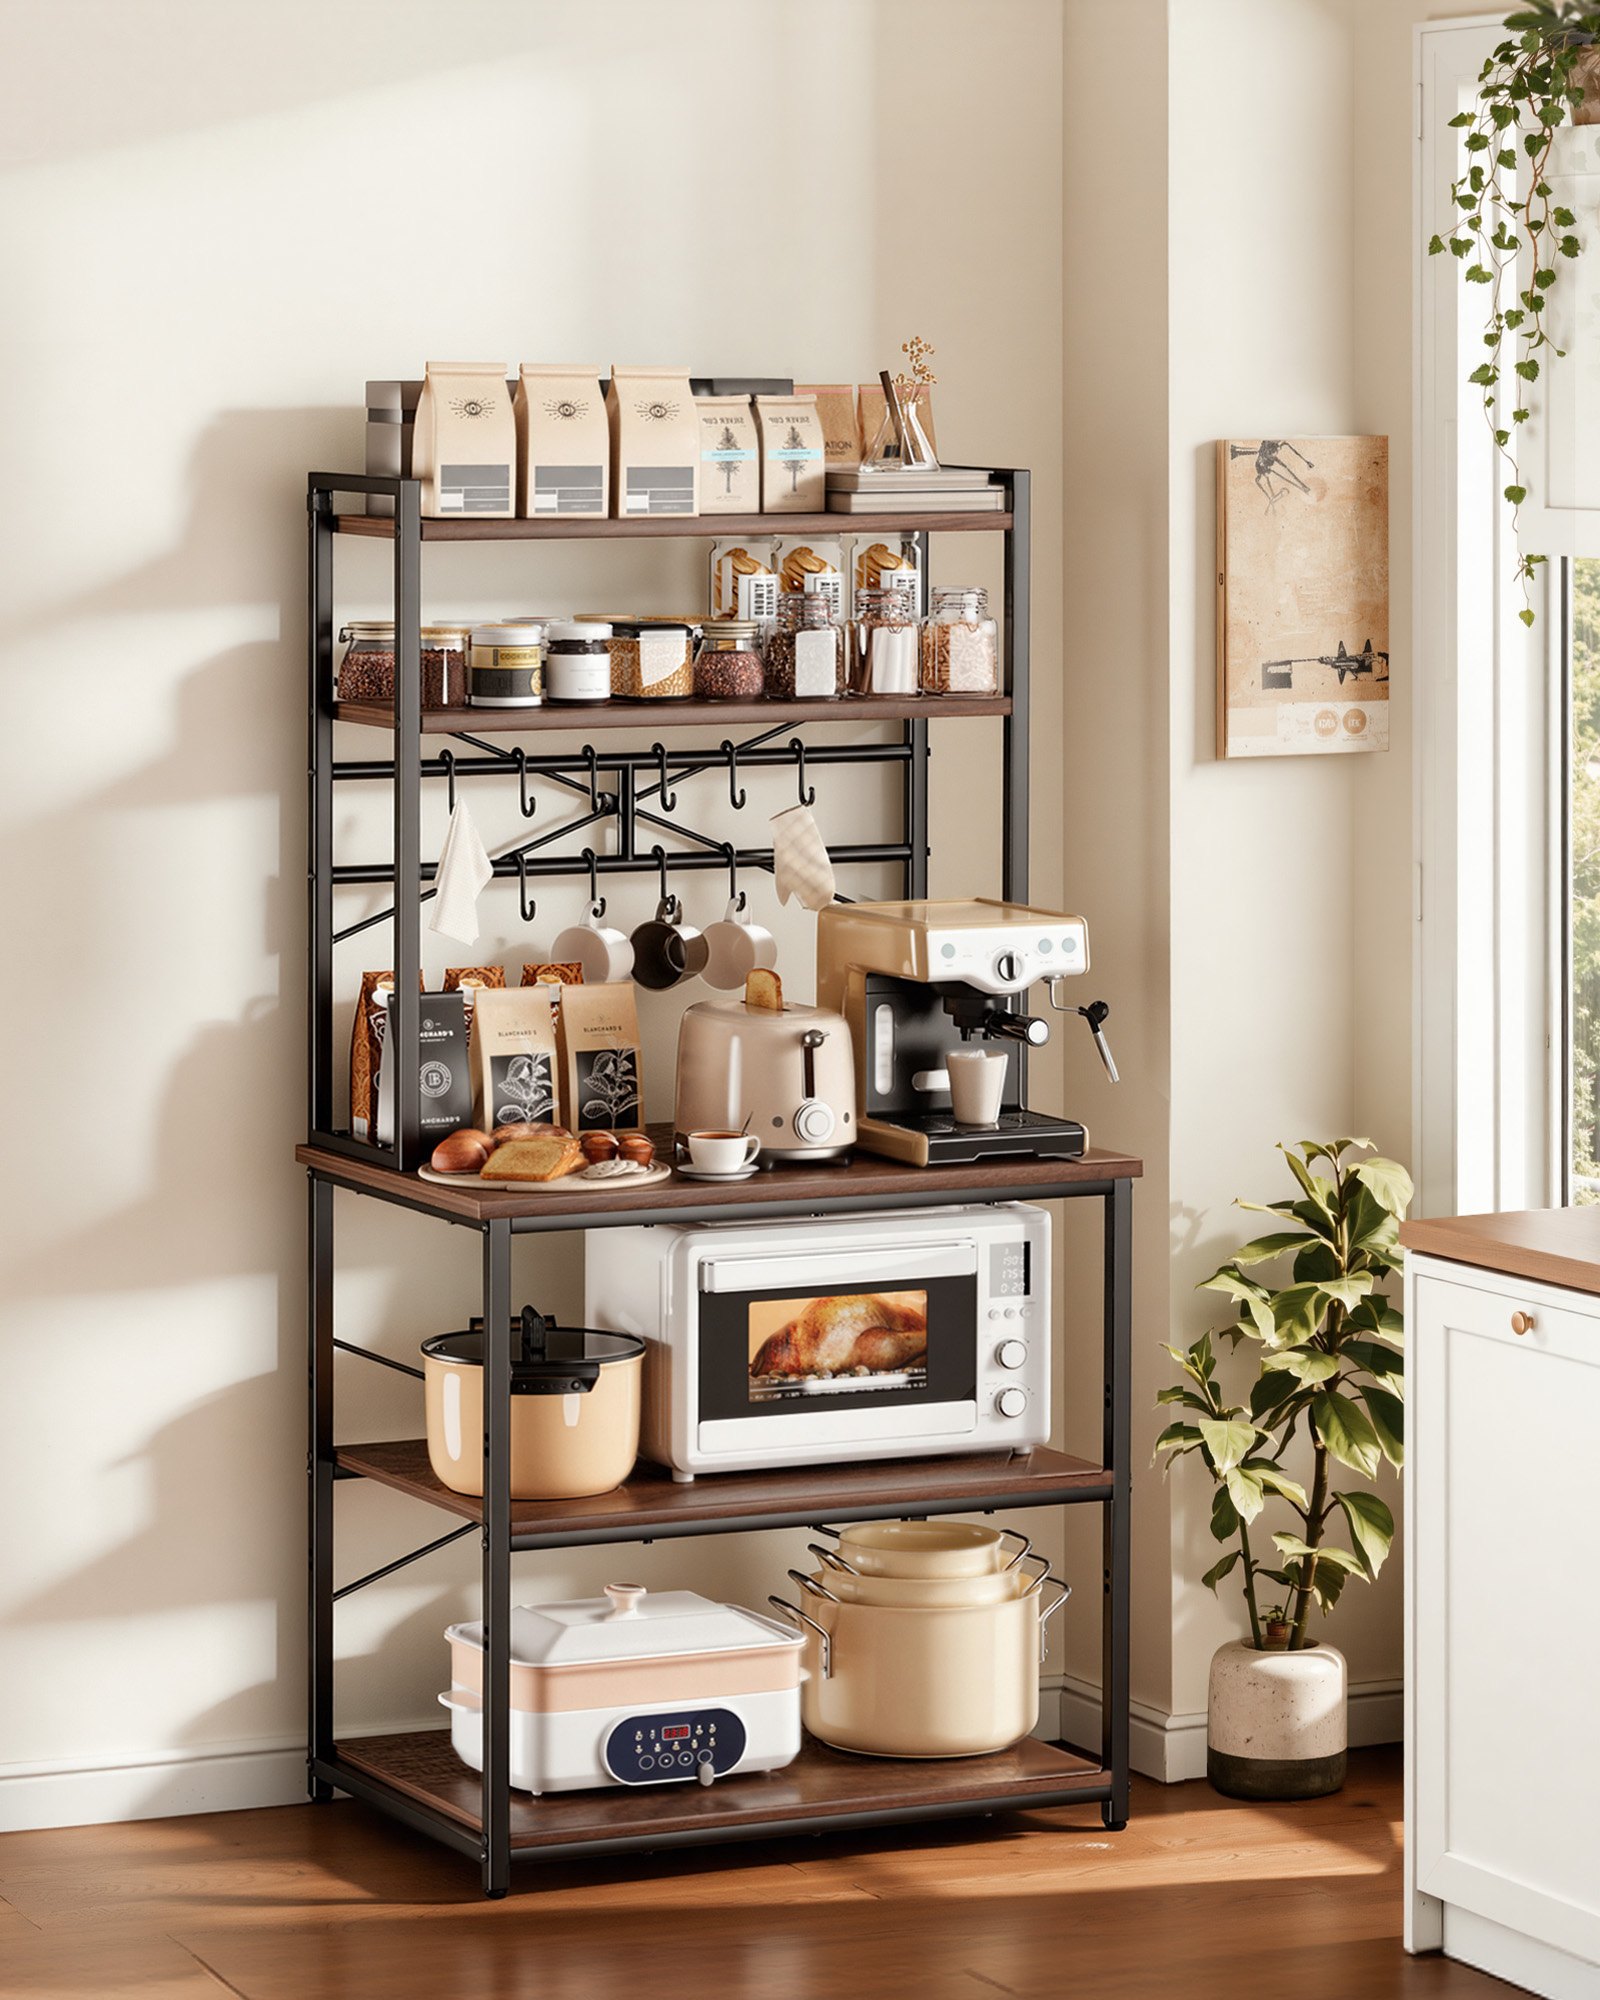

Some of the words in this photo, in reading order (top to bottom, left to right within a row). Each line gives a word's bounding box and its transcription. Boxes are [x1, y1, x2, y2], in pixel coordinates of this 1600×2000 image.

[825, 441, 852, 450] ATION
[754, 583, 765, 615] ALMOND
[766, 583, 775, 615] SMOKED
[421, 1116, 460, 1124] ANCHARD'S
